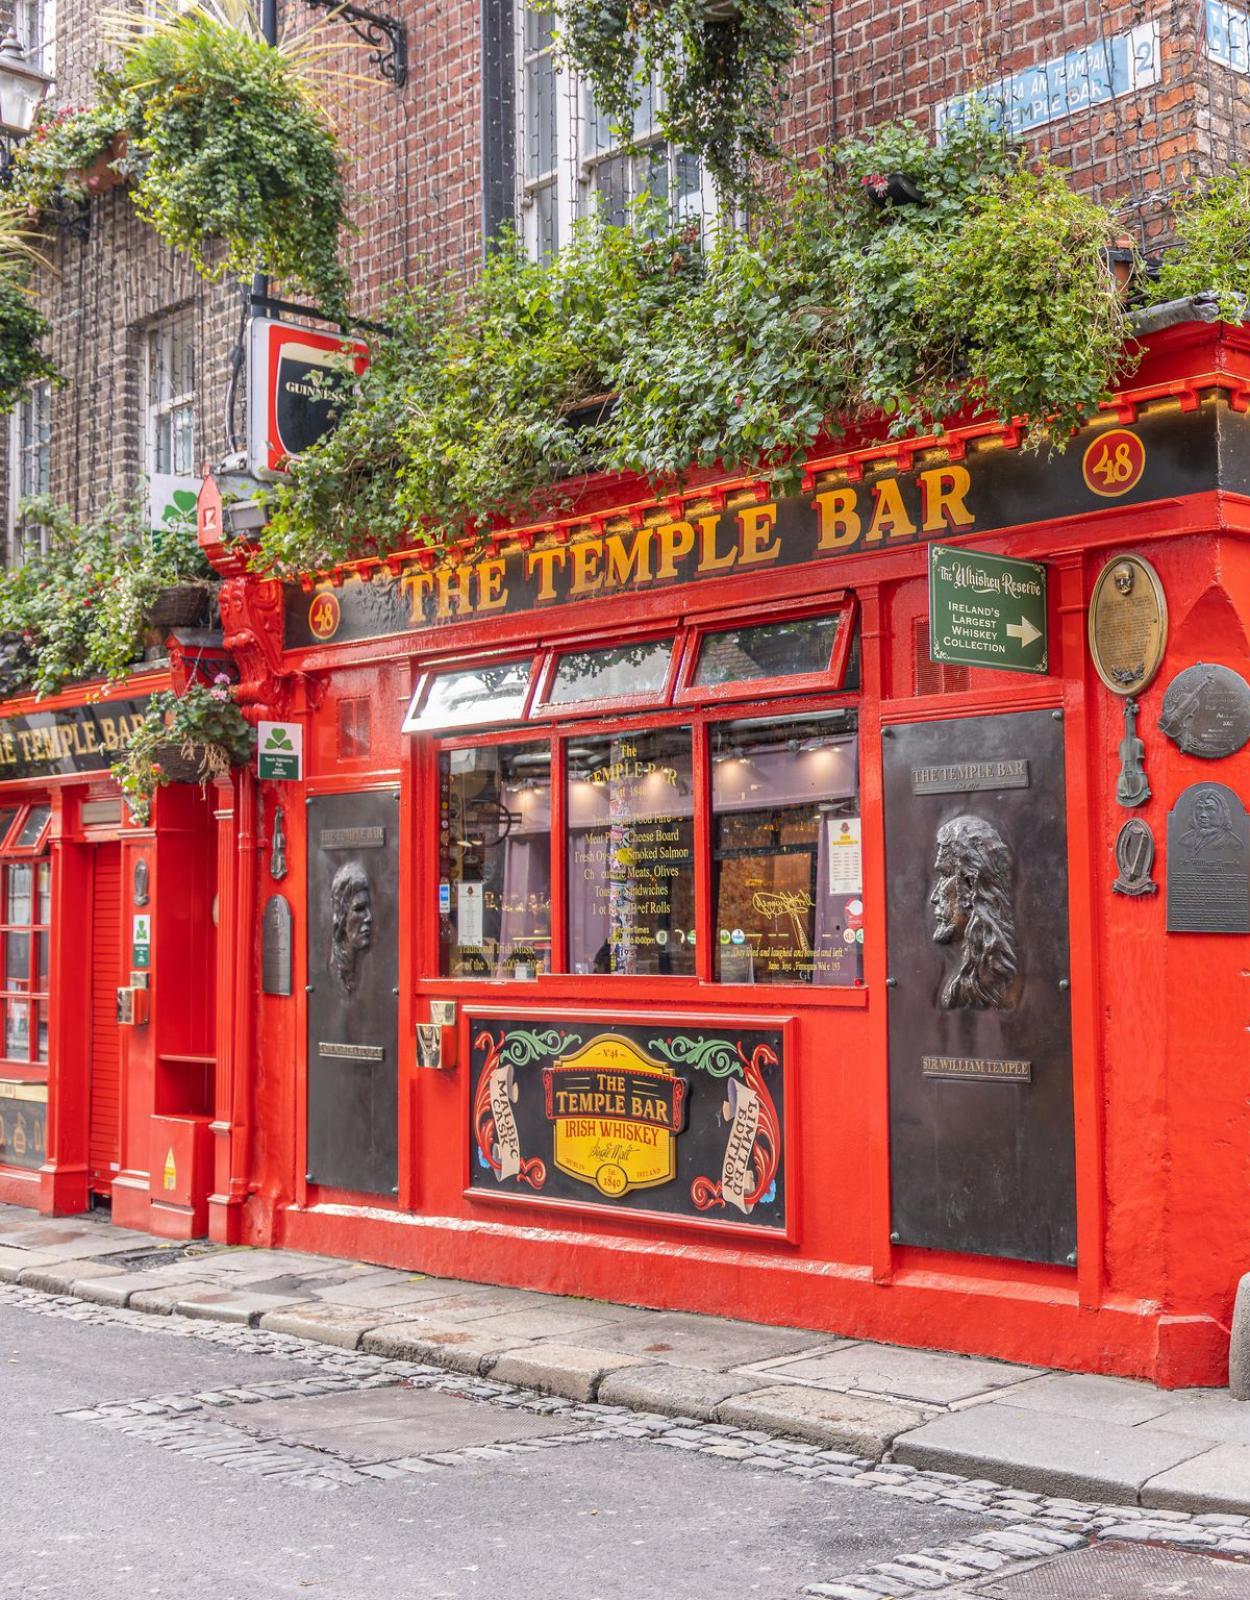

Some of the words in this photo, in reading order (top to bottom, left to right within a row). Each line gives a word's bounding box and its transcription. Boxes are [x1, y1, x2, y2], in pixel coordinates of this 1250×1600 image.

[1136, 41, 1152, 72] 2
[1031, 75, 1047, 96] AN
[1068, 80, 1104, 106] BAR
[285, 381, 347, 401] GUINNESS
[1092, 443, 1133, 486] 48
[402, 560, 509, 625] THE
[526, 503, 782, 604] TEMPLE
[813, 465, 976, 553] BAR
[938, 566, 953, 582] The
[952, 561, 1001, 595] Whiskey
[1001, 572, 1041, 599] Reserve
[314, 604, 333, 632] 48
[948, 601, 1000, 618] IRELAND'S
[952, 614, 997, 629] LARGEST
[951, 625, 998, 641] WHISKEY
[943, 636, 1006, 653] COLLECTION
[17, 720, 100, 761] TEMPLE
[620, 745, 637, 759] The
[584, 762, 643, 785] EMPLE
[912, 768, 938, 783] THE
[942, 763, 994, 781] TEMPLE
[996, 760, 1025, 777] BAR
[655, 827, 680, 842] Board
[659, 843, 689, 859] Salmon
[653, 864, 679, 878] Olives
[649, 899, 671, 914] Rolls
[922, 1057, 938, 1070] SIR
[939, 1058, 985, 1073] WILLIAM
[986, 1061, 1029, 1075] TEMPLE
[596, 1073, 626, 1093] THE
[555, 1090, 626, 1116] TEMPLE
[631, 1096, 670, 1124] BAR
[492, 1098, 510, 1149] CASK
[496, 1079, 519, 1160] MALBEC
[565, 1119, 596, 1139] IRISH
[600, 1121, 660, 1147] WHISKEY
[723, 1105, 748, 1191] EDITION
[734, 1100, 758, 1198] LIMITED
[603, 1176, 622, 1189] 1840
[636, 1167, 662, 1178] IRELAND
